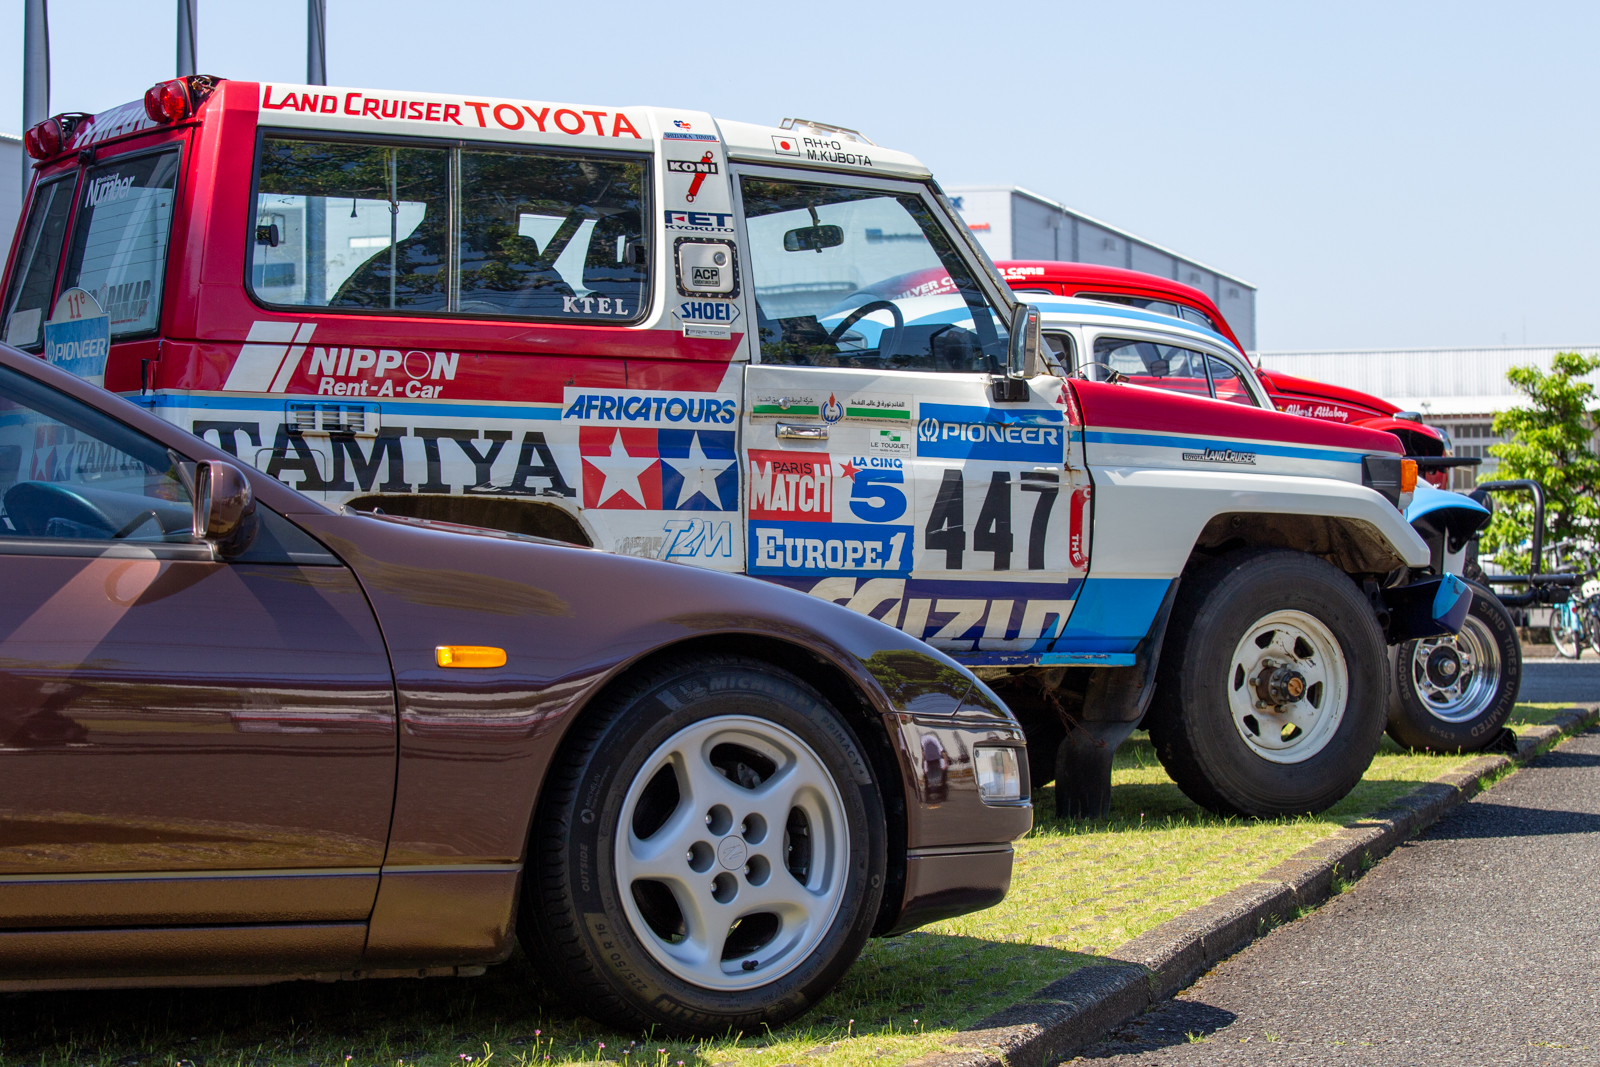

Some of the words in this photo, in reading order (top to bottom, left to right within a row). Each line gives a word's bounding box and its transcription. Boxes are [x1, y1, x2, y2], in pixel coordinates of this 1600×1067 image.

[261, 85, 338, 113] LAND
[344, 92, 464, 126] CRUISER
[464, 101, 642, 139] TOYOTA
[669, 161, 717, 172] KONI
[807, 149, 872, 166] M.KUBOTA
[85, 173, 135, 208] Number
[664, 210, 733, 227] FET
[665, 224, 734, 233] KYOKUTO
[694, 269, 718, 279] ACP
[1007, 267, 1045, 275] CARE
[562, 296, 628, 315] KTEL
[680, 302, 730, 320] SHOEI
[54, 338, 107, 361] PIONEER
[308, 347, 460, 380] NIPPON
[318, 377, 443, 399] Rent-A-Car
[563, 395, 736, 424] AFRICATOURS
[1285, 404, 1313, 417] Albert
[1314, 406, 1349, 422] Attaboy
[942, 423, 1059, 445] PIONEER
[192, 420, 577, 498] TAMIYA
[853, 456, 867, 467] LA
[870, 457, 903, 469] CINQ
[1226, 448, 1257, 464] CRUISER
[773, 461, 812, 474] PARIS
[751, 461, 831, 513] MATCH
[849, 468, 907, 523] 5
[925, 469, 1059, 571] 447
[1479, 601, 1506, 632] SAND
[1504, 634, 1517, 676] TIRES
[709, 676, 811, 707] MICHELIN
[1470, 681, 1516, 737] UNLIMITED
[820, 716, 861, 766] PRIMACY
[580, 843, 591, 893] OUTSIDE
[595, 923, 606, 937] 16
[603, 940, 614, 950] R
[610, 952, 648, 992] 225/50
